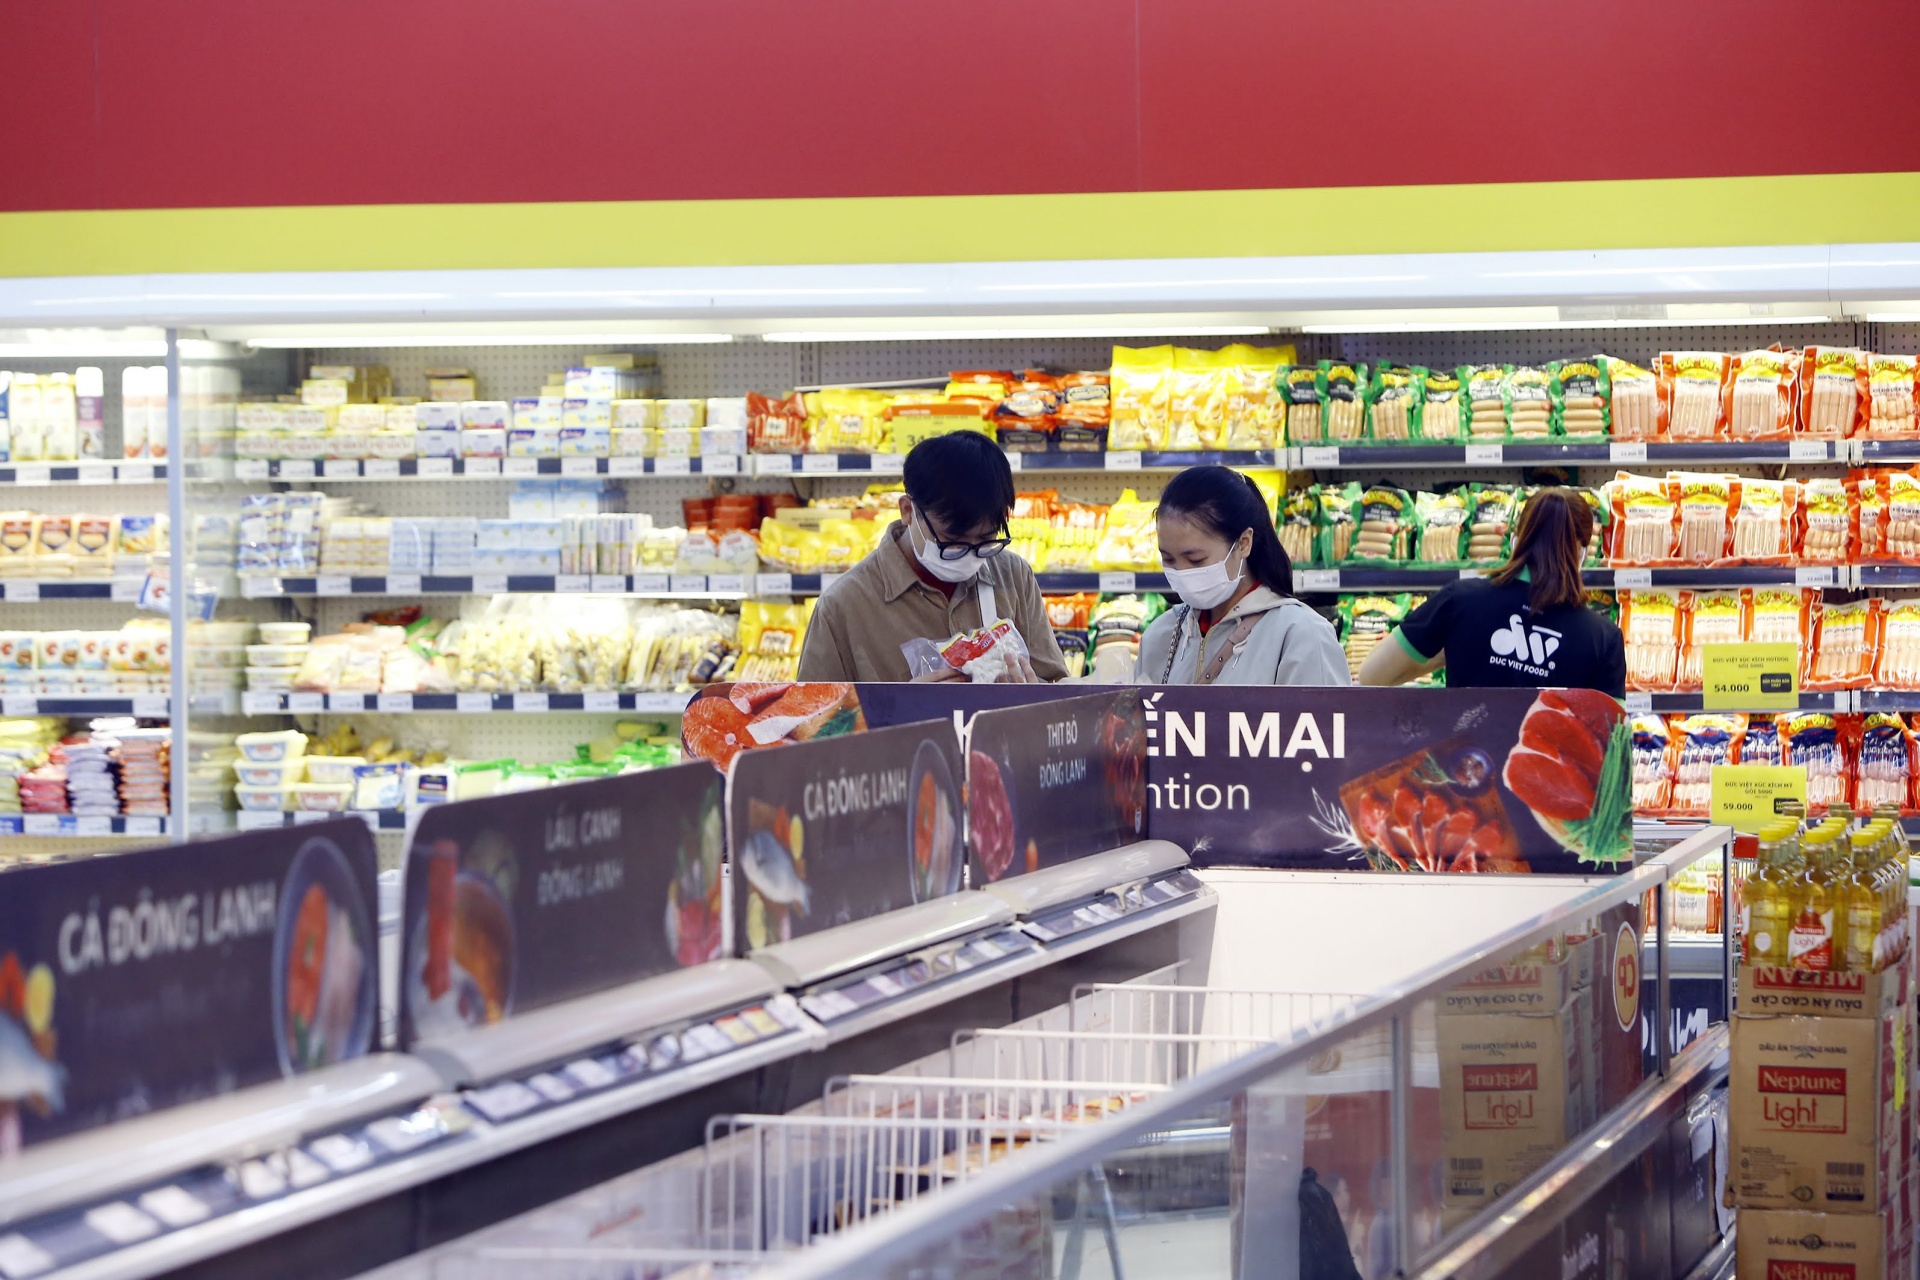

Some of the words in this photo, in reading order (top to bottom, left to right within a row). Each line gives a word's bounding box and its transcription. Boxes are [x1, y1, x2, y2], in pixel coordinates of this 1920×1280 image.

[1489, 655, 1507, 666] DUC
[1508, 659, 1523, 672] VIET
[1523, 664, 1549, 678] FOODS
[1714, 683, 1750, 693] 54.000
[1046, 722, 1064, 754] THỊT
[1228, 711, 1345, 773] MẠI
[1723, 802, 1753, 811] 59.000
[58, 894, 105, 976] CÁ
[107, 886, 200, 966] ĐÔNG
[203, 881, 277, 957] LẠNH
[1781, 995, 1809, 1006] CAO
[1763, 1070, 1842, 1092] Neptune
[1763, 1096, 1818, 1130] Light
